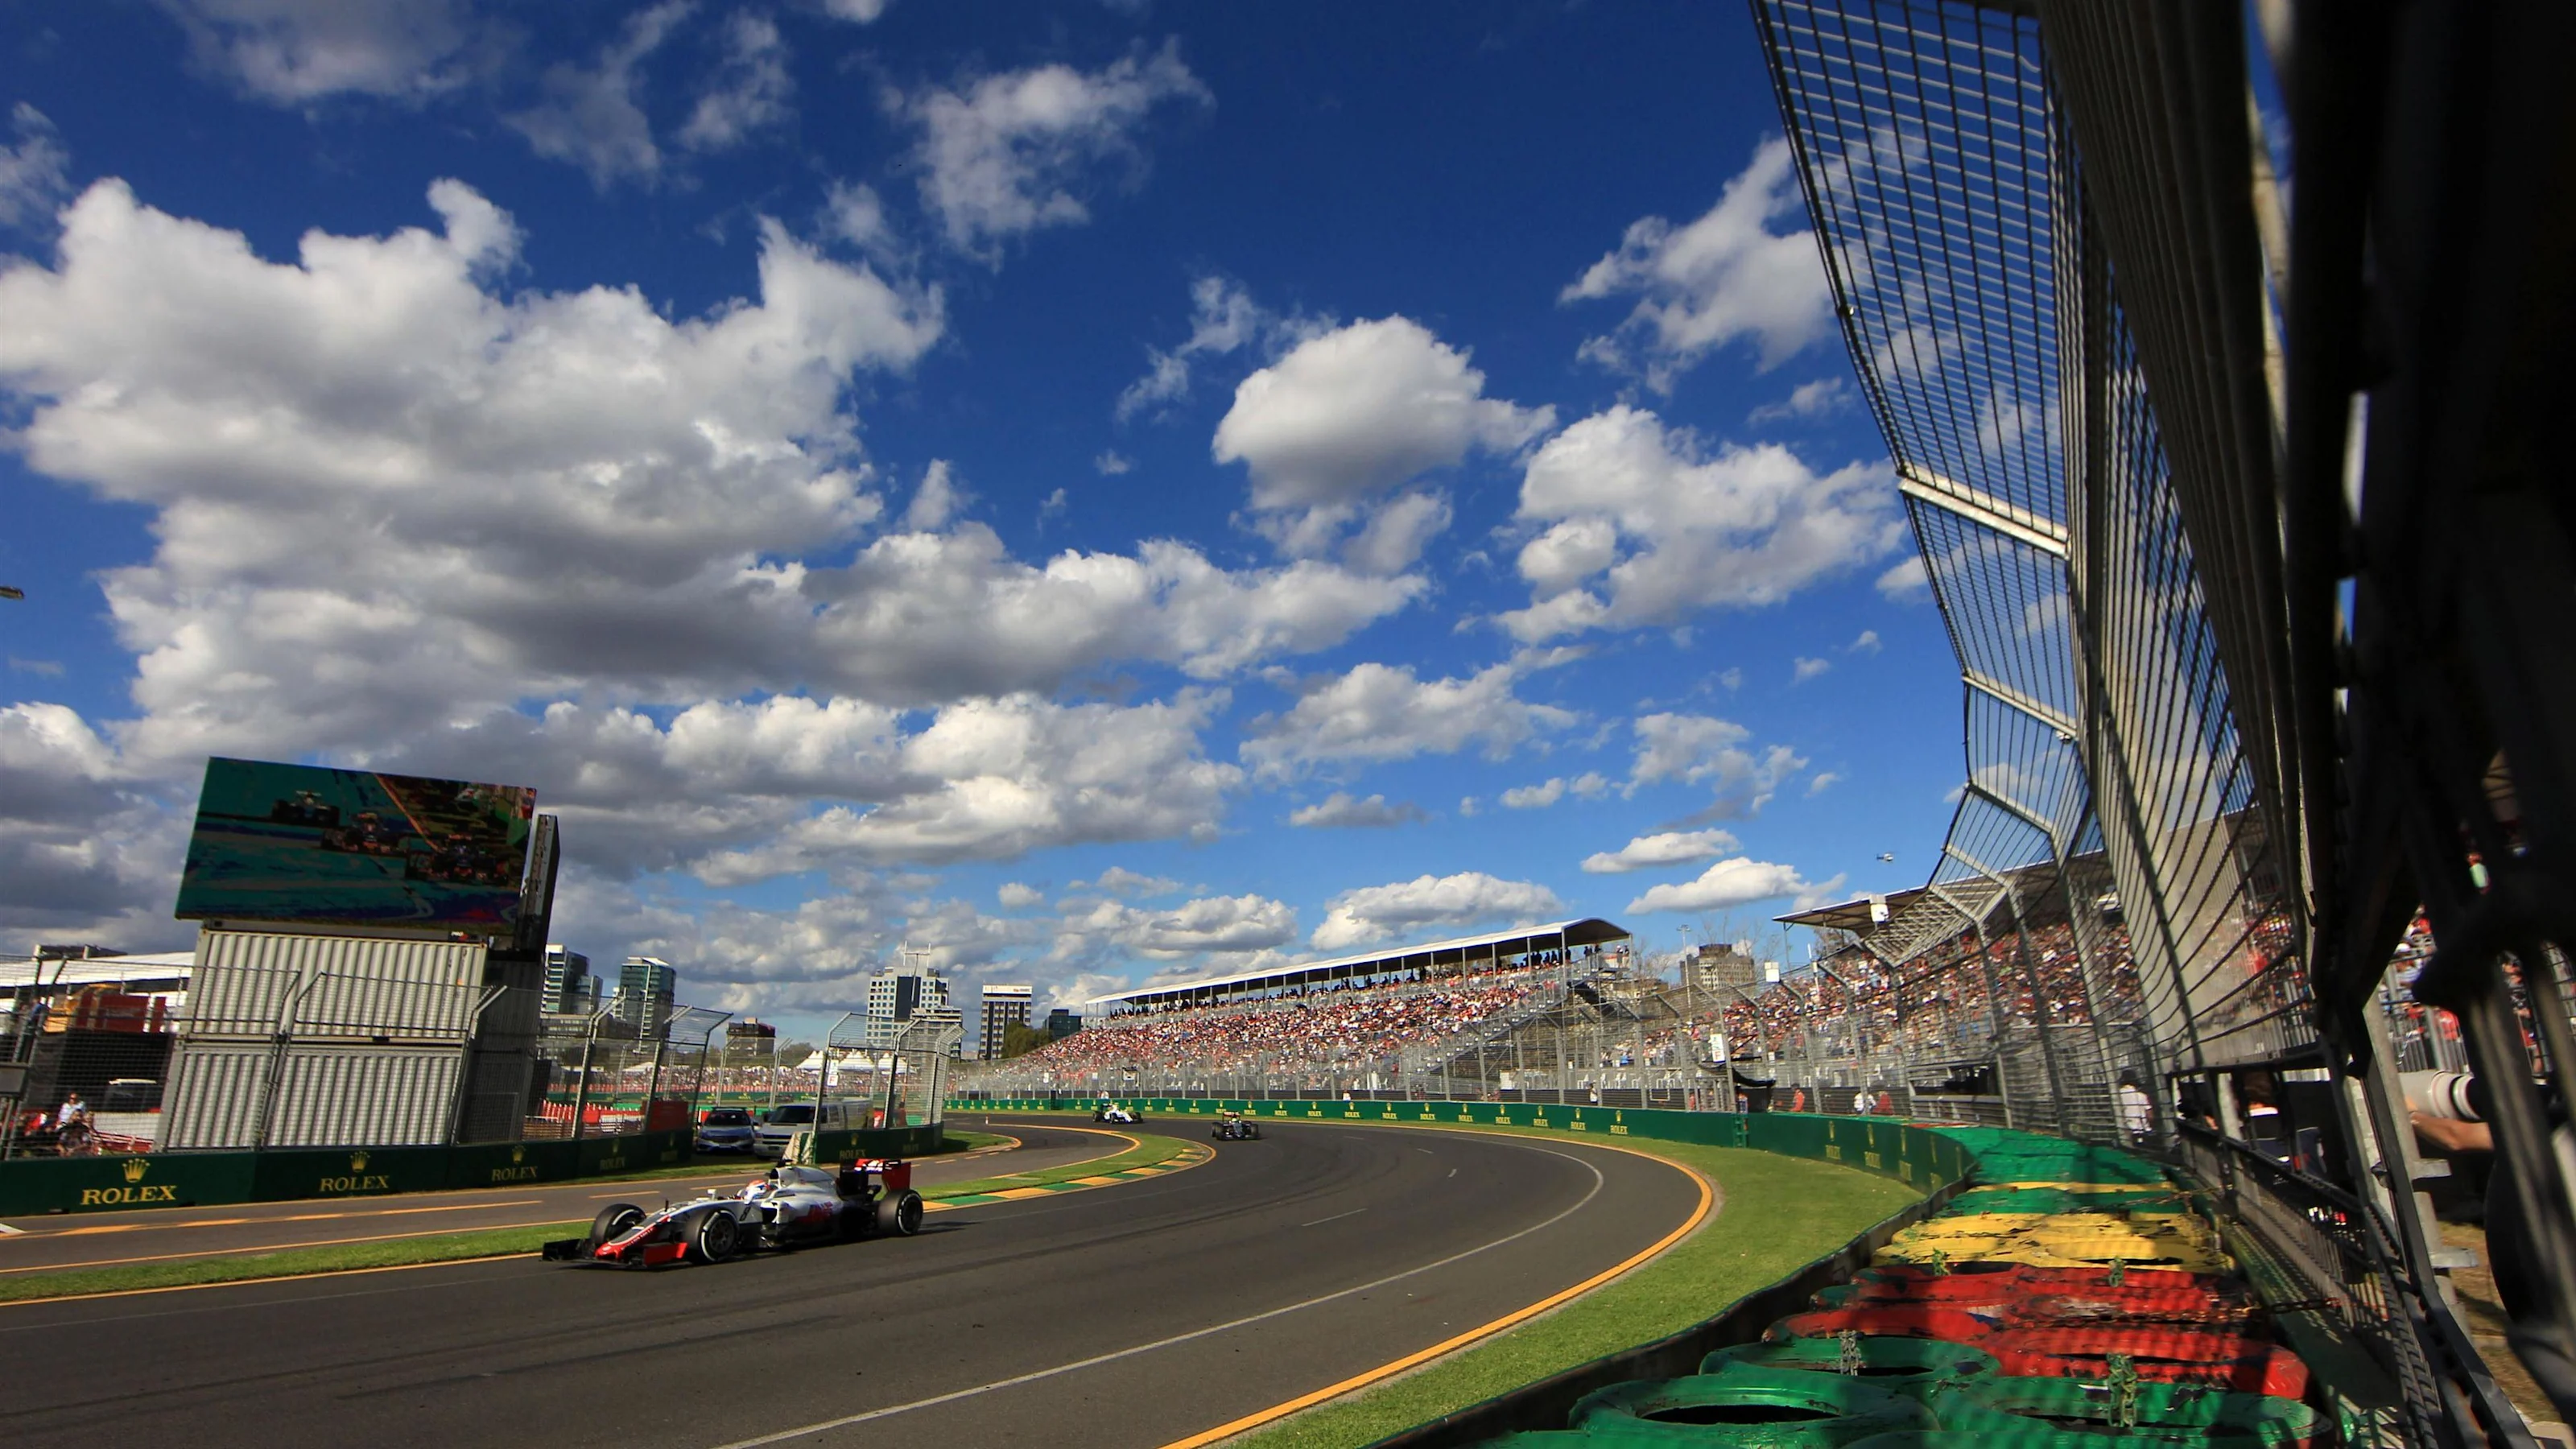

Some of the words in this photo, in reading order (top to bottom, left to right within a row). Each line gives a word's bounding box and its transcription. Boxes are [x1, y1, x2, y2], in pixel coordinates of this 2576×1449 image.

[1459, 1114, 1473, 1122] ROLEX
[1495, 1117, 1511, 1125] ROLEX
[1533, 1118, 1548, 1127] ROLEX
[1571, 1121, 1586, 1130] ROLEX
[1610, 1125, 1628, 1135] ROLEX
[840, 1150, 865, 1159] ROLEX
[491, 1166, 538, 1182] ROLEX
[320, 1175, 390, 1192] ROLEX
[80, 1185, 176, 1205] ROLEX
[740, 1207, 751, 1222] 8
